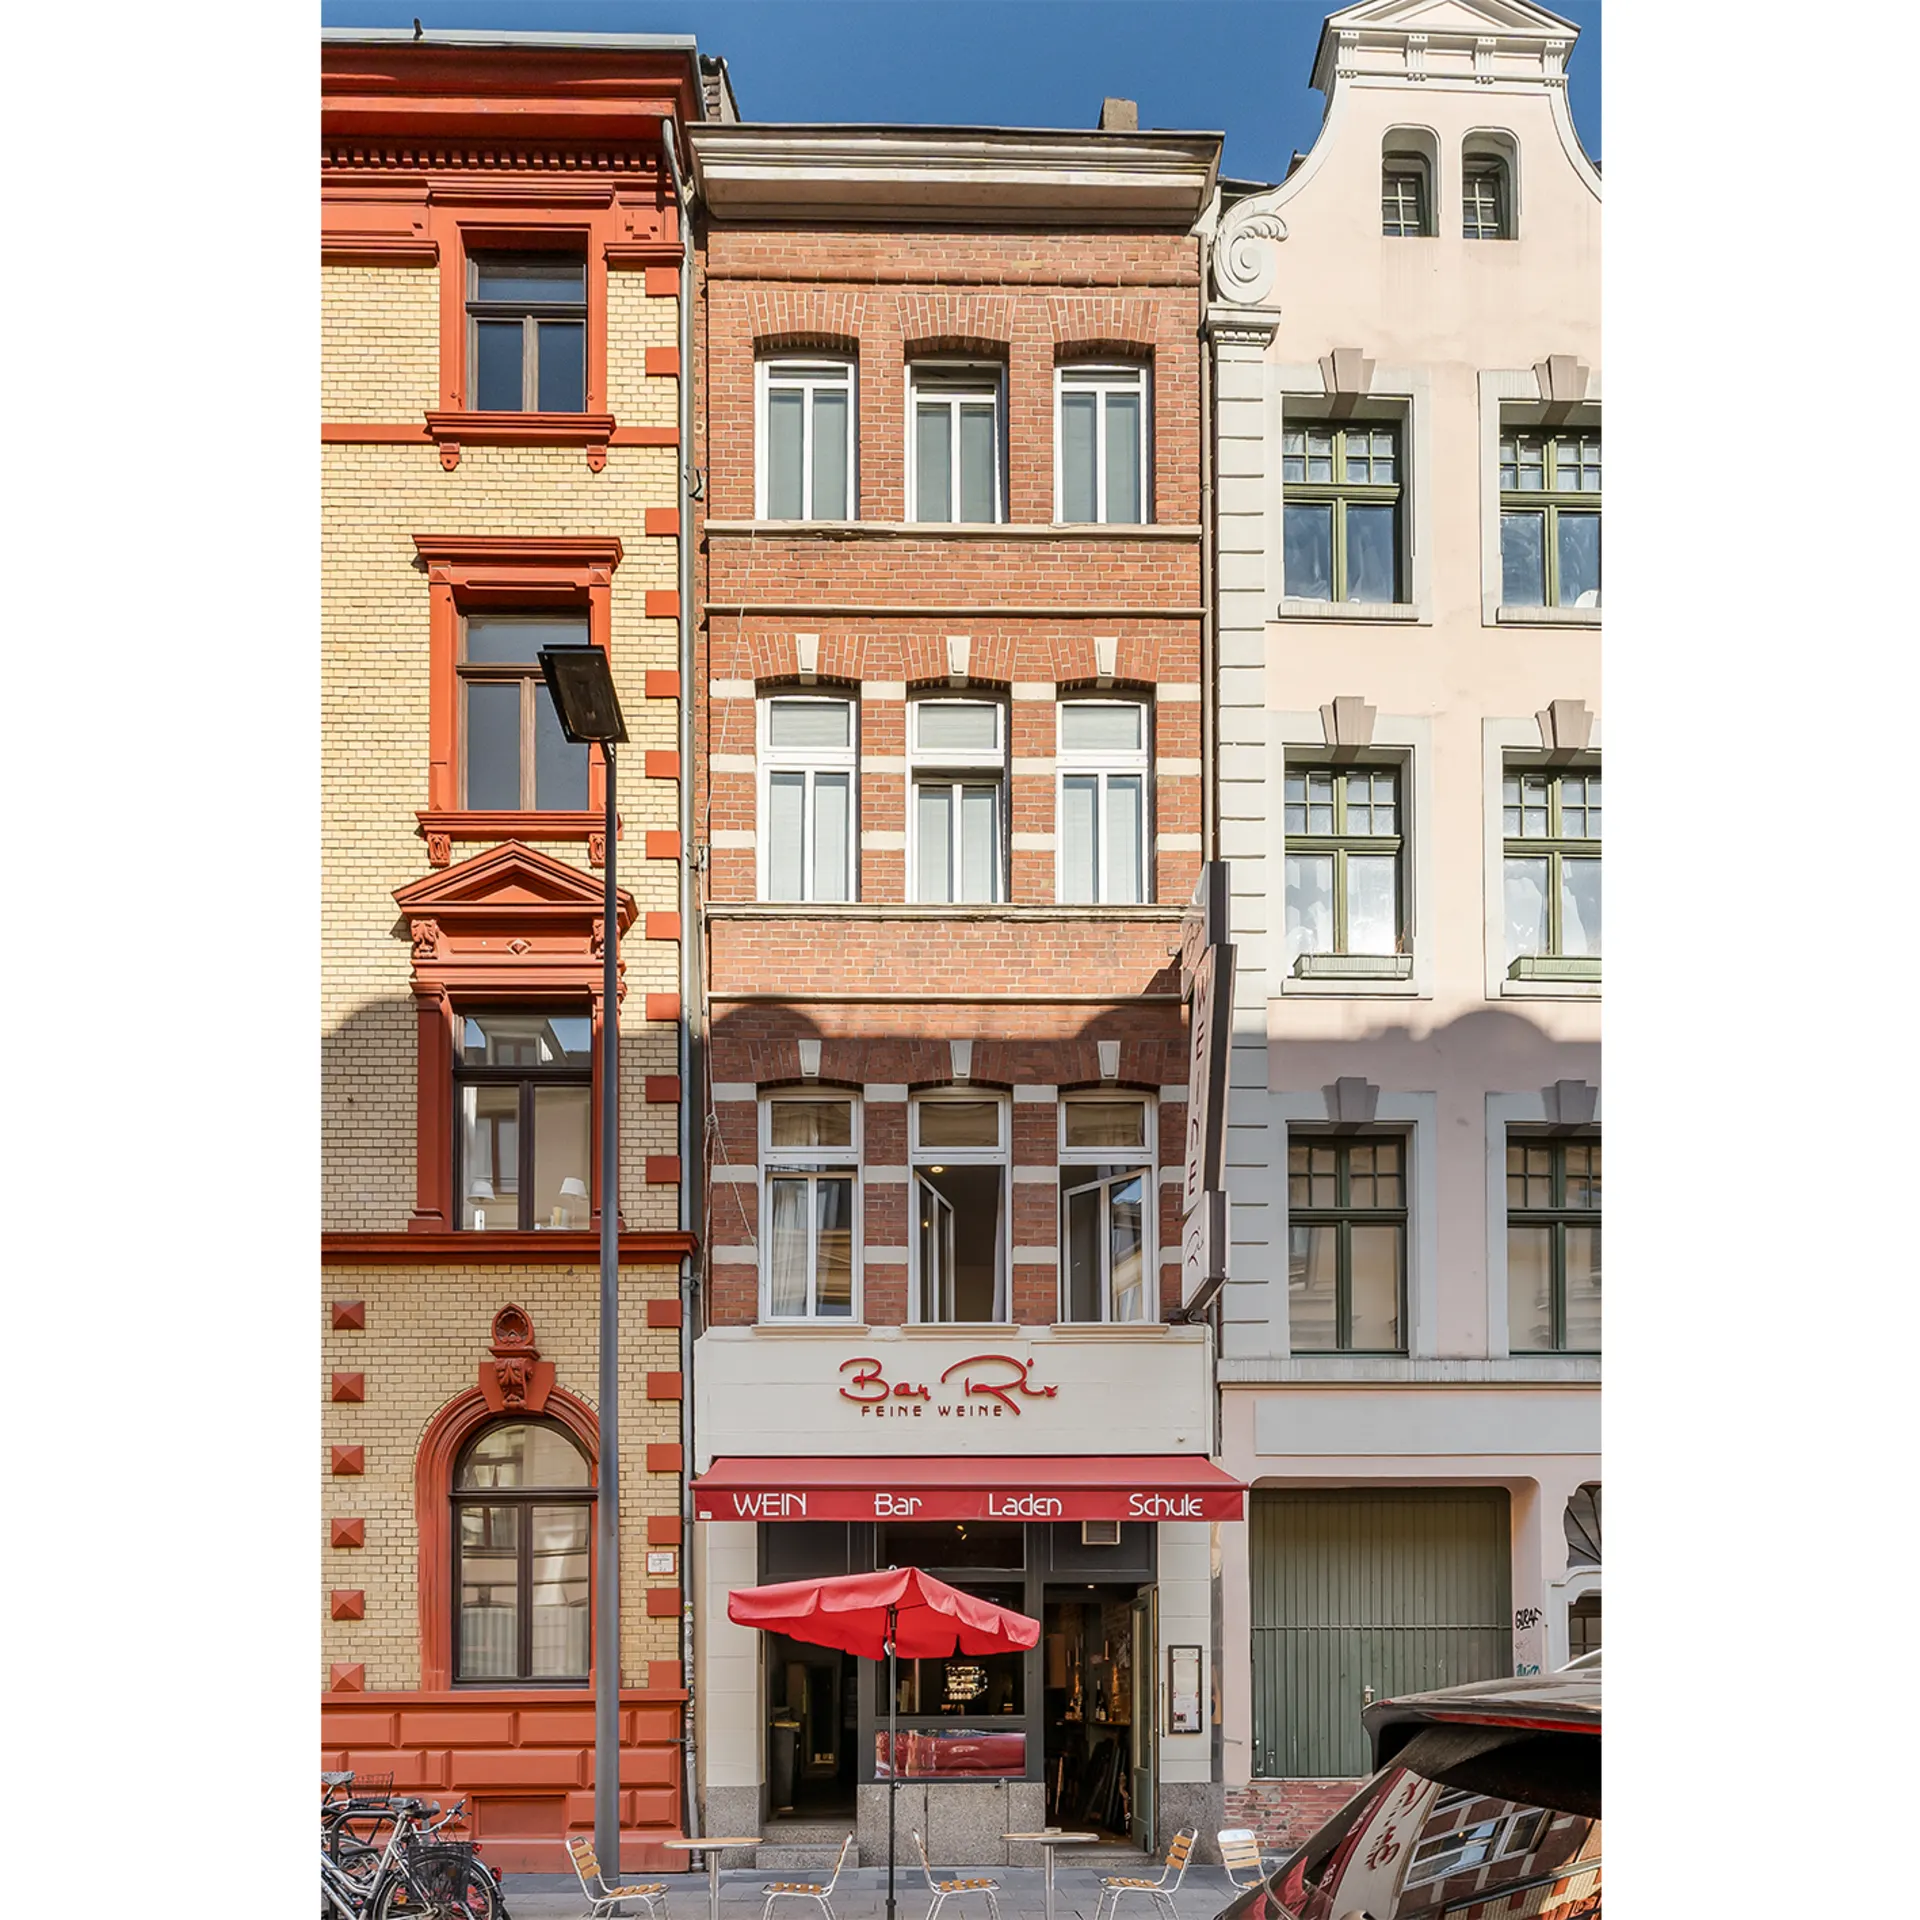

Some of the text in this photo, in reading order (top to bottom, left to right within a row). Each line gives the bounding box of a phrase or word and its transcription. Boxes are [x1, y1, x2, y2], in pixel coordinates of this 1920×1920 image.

[839, 1357, 932, 1402] Bar
[860, 1404, 1004, 1417] FEINE WEINE
[733, 1493, 1204, 1516] WEIN Bar Laden Schule
